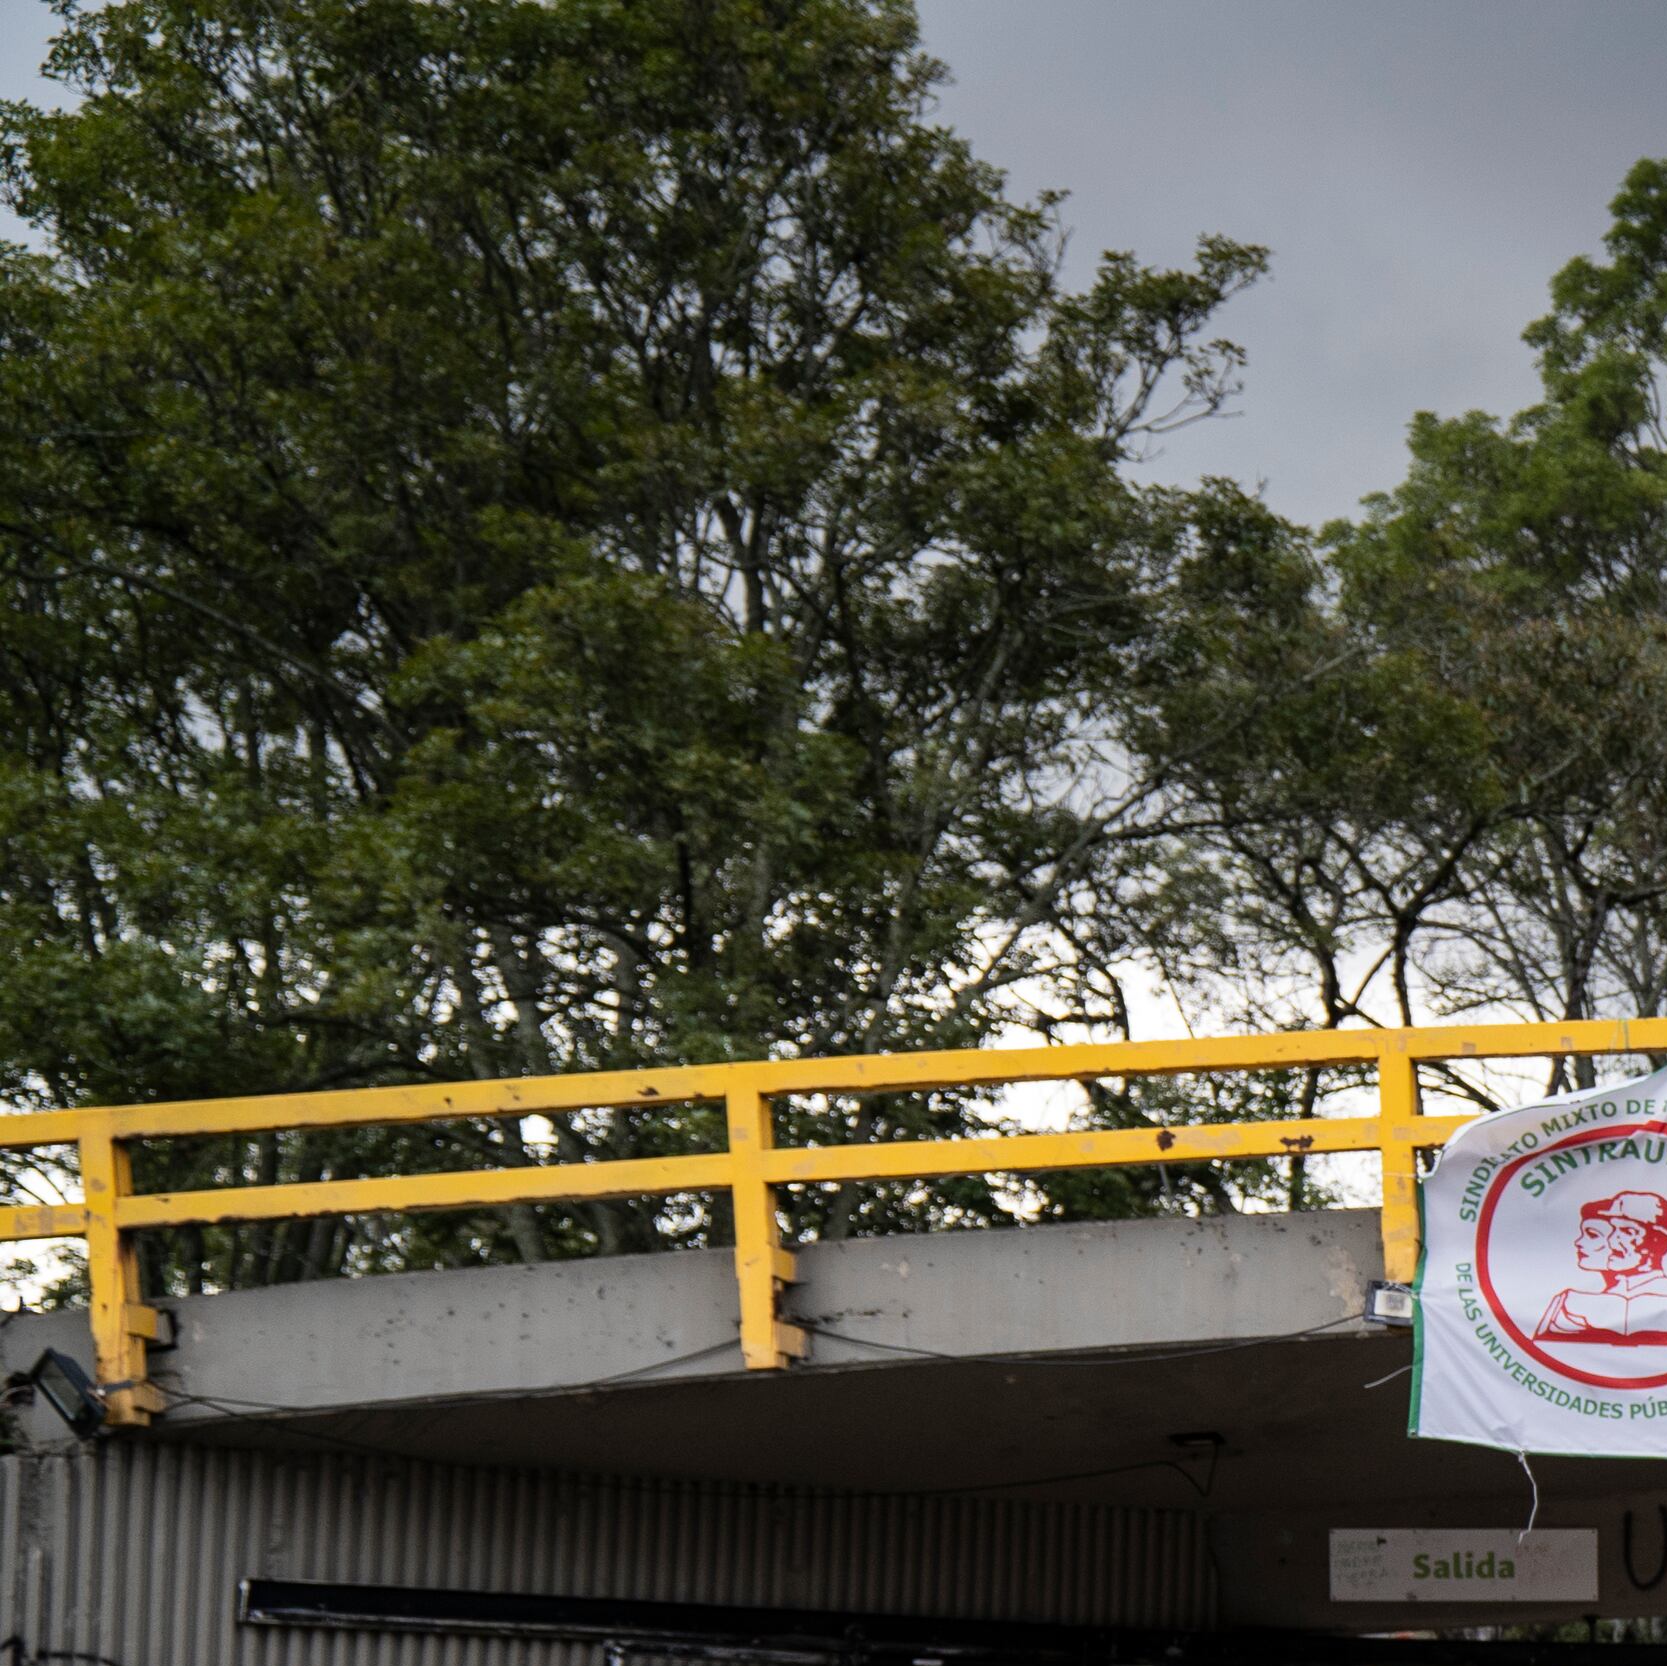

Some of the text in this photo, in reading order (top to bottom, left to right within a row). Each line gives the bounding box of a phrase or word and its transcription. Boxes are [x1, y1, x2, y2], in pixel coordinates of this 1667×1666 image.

[1541, 1101, 1617, 1138] MIXTO
[1626, 1098, 1656, 1116] DE
[1455, 1262, 1473, 1284] DE
[1456, 1287, 1485, 1322] LAS
[1475, 1324, 1625, 1420] UNIVERSIDADES
[1412, 1551, 1516, 1579] Salida
